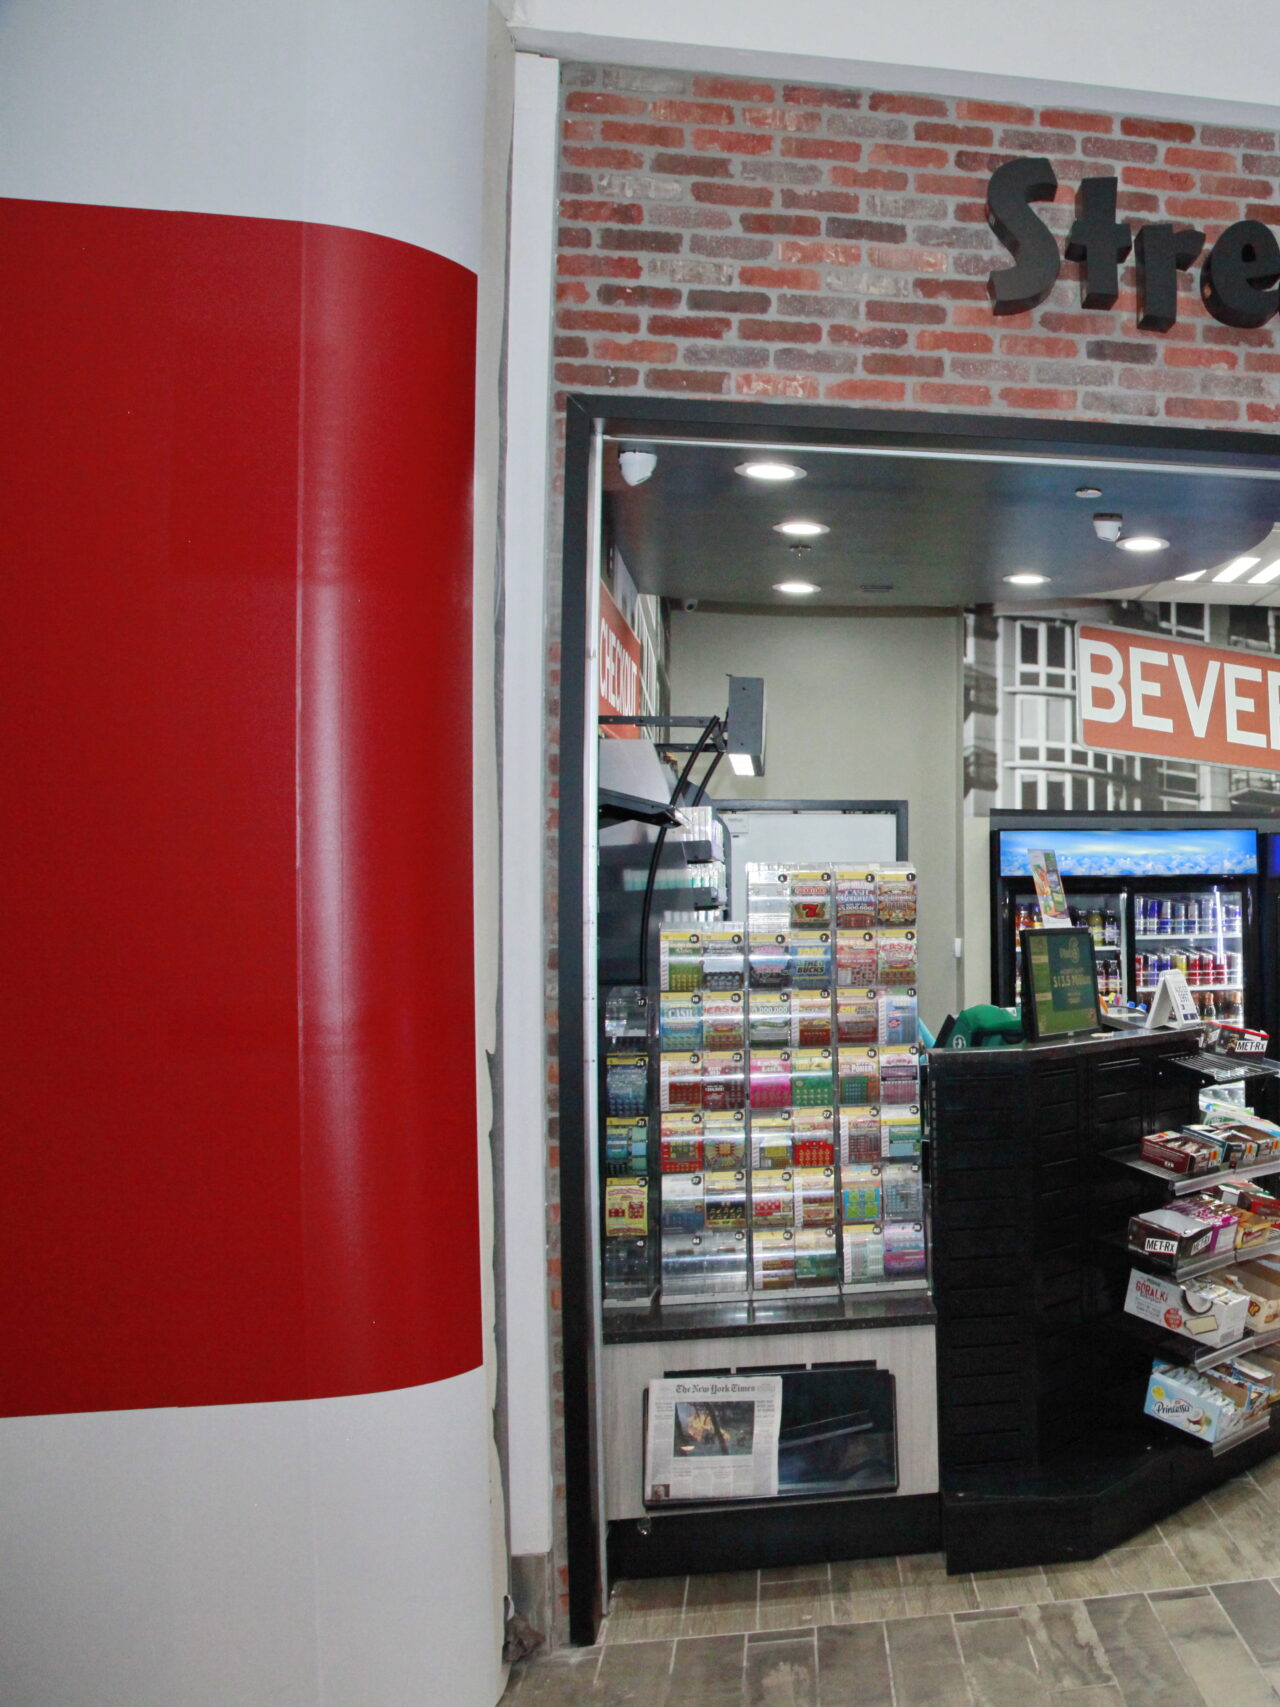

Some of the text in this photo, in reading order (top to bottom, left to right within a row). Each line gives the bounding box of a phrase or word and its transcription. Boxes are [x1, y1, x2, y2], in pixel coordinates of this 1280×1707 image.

[675, 1384, 690, 1394] The
[692, 1384, 710, 1393] New
[710, 1384, 730, 1395] York
